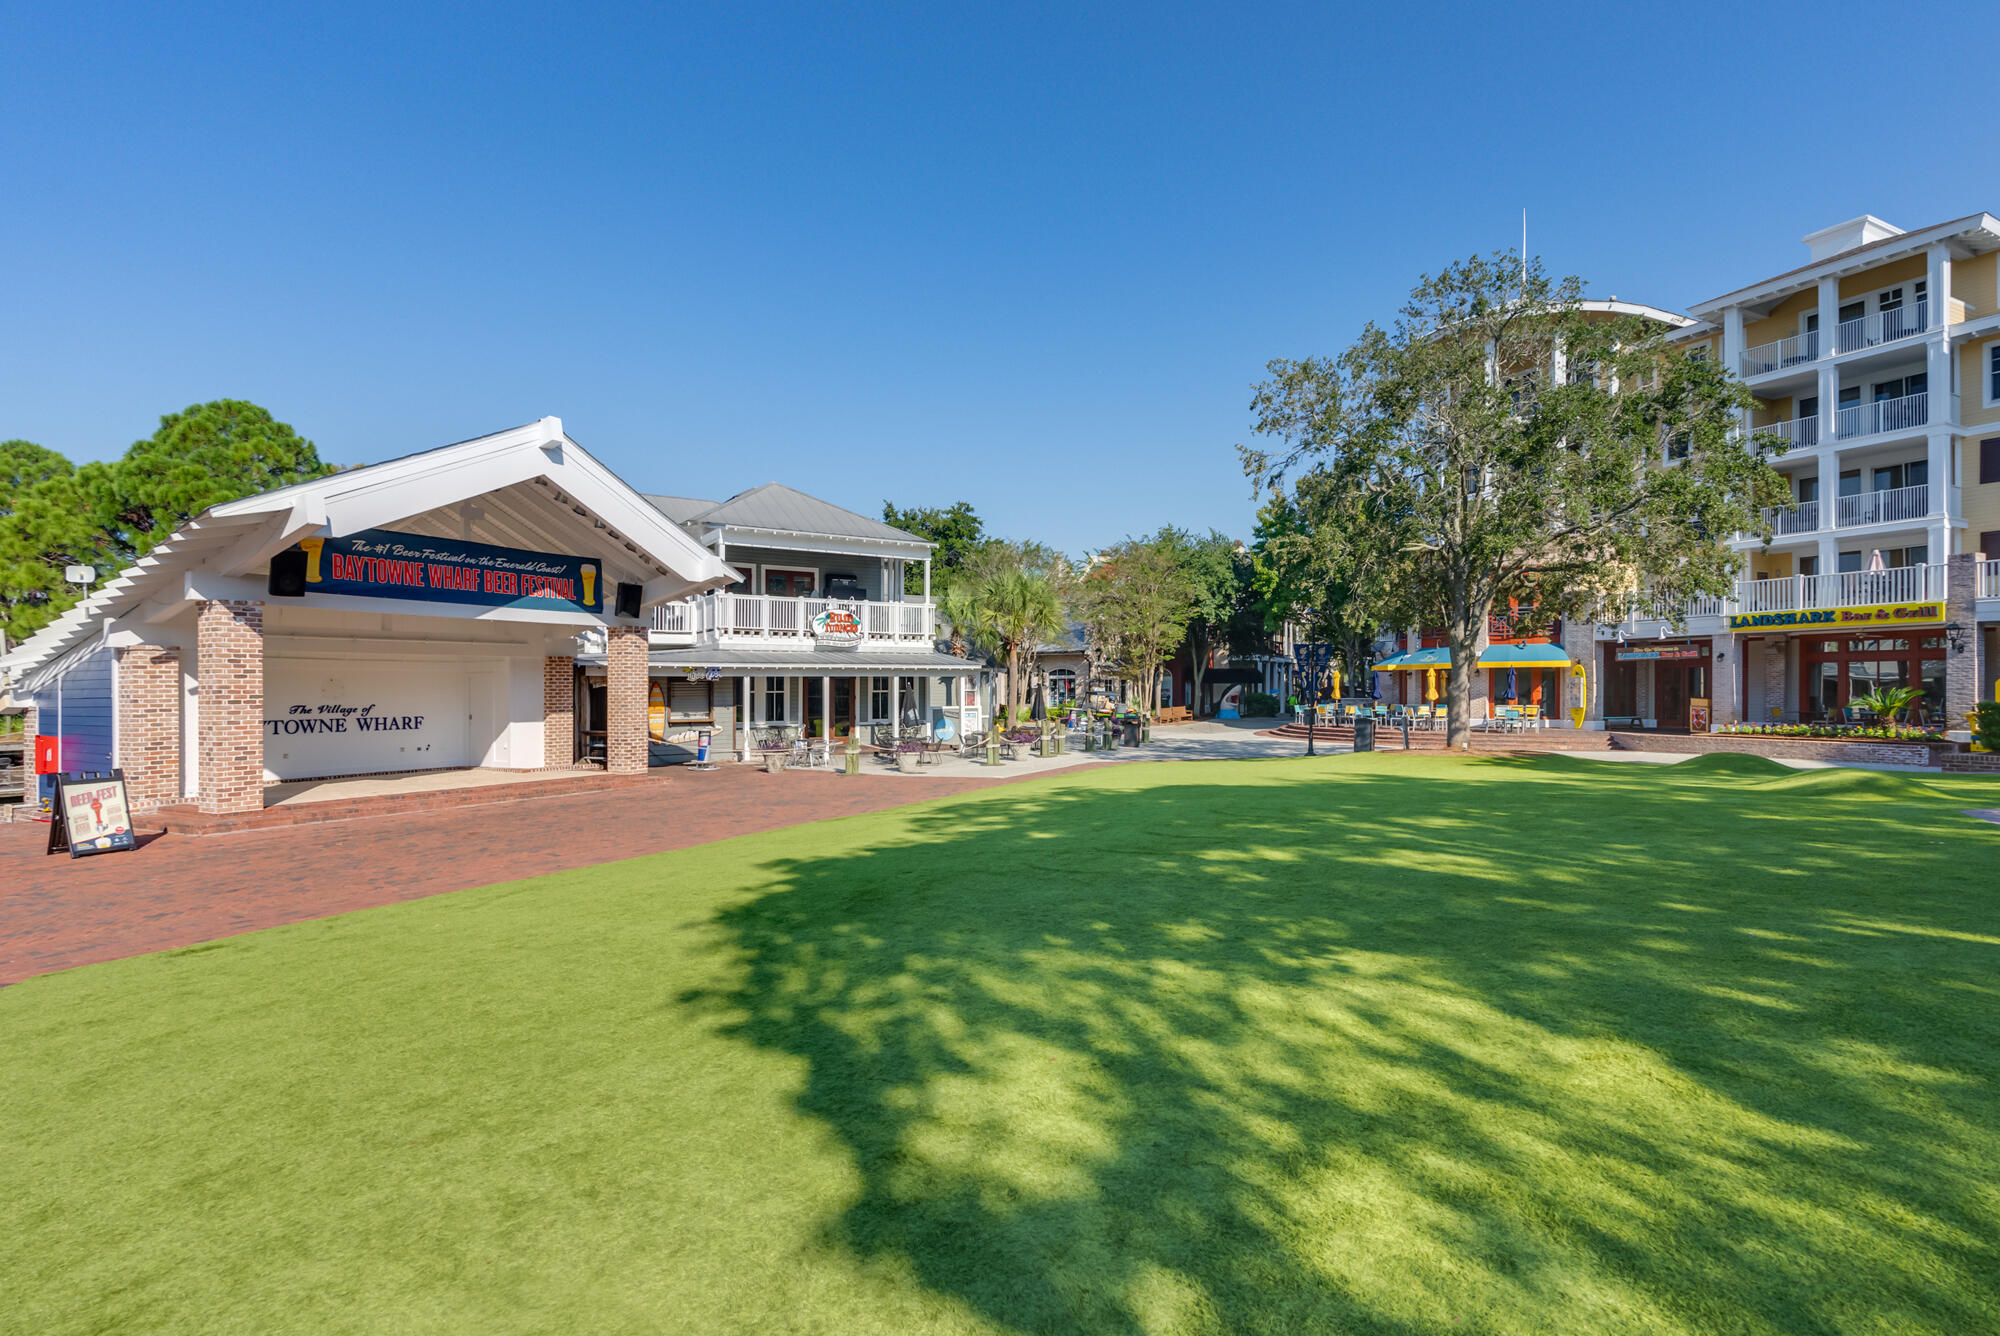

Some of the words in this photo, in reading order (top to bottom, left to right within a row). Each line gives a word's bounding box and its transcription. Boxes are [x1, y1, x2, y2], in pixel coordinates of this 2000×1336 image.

[351, 539, 373, 552] The
[374, 543, 391, 555] #1
[391, 544, 421, 559] Beer
[421, 548, 466, 563] Festival
[478, 556, 496, 567] the
[494, 557, 538, 571] Emerald
[535, 562, 567, 574] Coast!
[332, 553, 425, 587] BAYTOWNE
[428, 564, 480, 592] WHARF
[484, 570, 518, 595] BEER
[521, 575, 577, 600] FESTIVAL
[1730, 610, 1836, 629] LANDSHARK
[1841, 610, 1872, 622] Bar
[1874, 609, 1890, 620] &
[1892, 605, 1938, 619] Grill
[289, 705, 313, 715] The
[317, 705, 358, 717] Village
[361, 703, 376, 717] of
[356, 716, 424, 731] WHARF
[96, 786, 117, 800] FEST
